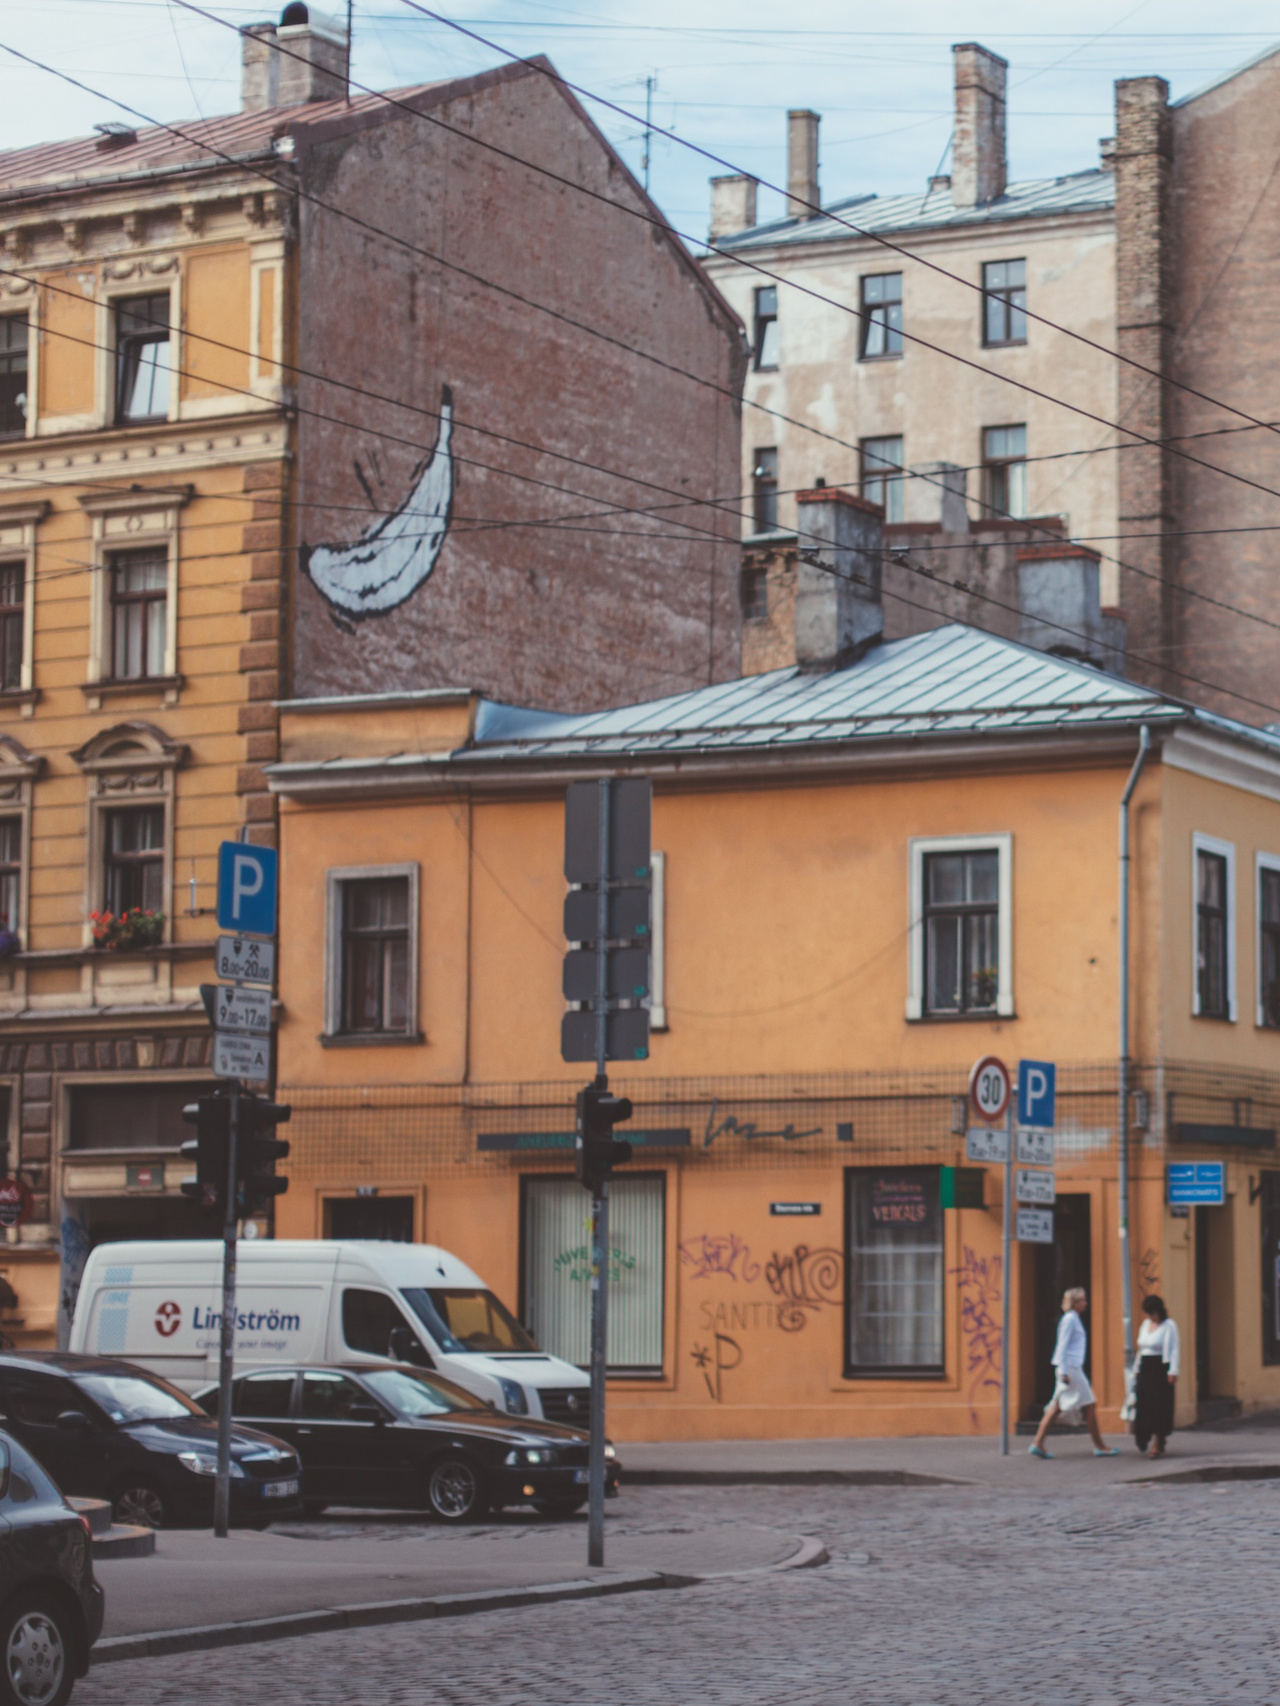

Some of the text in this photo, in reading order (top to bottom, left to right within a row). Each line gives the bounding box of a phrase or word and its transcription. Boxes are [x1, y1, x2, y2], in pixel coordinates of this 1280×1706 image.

[232, 854, 264, 919] P
[254, 1052, 264, 1066] A
[981, 1073, 1001, 1106] 30
[1026, 1068, 1047, 1117] P
